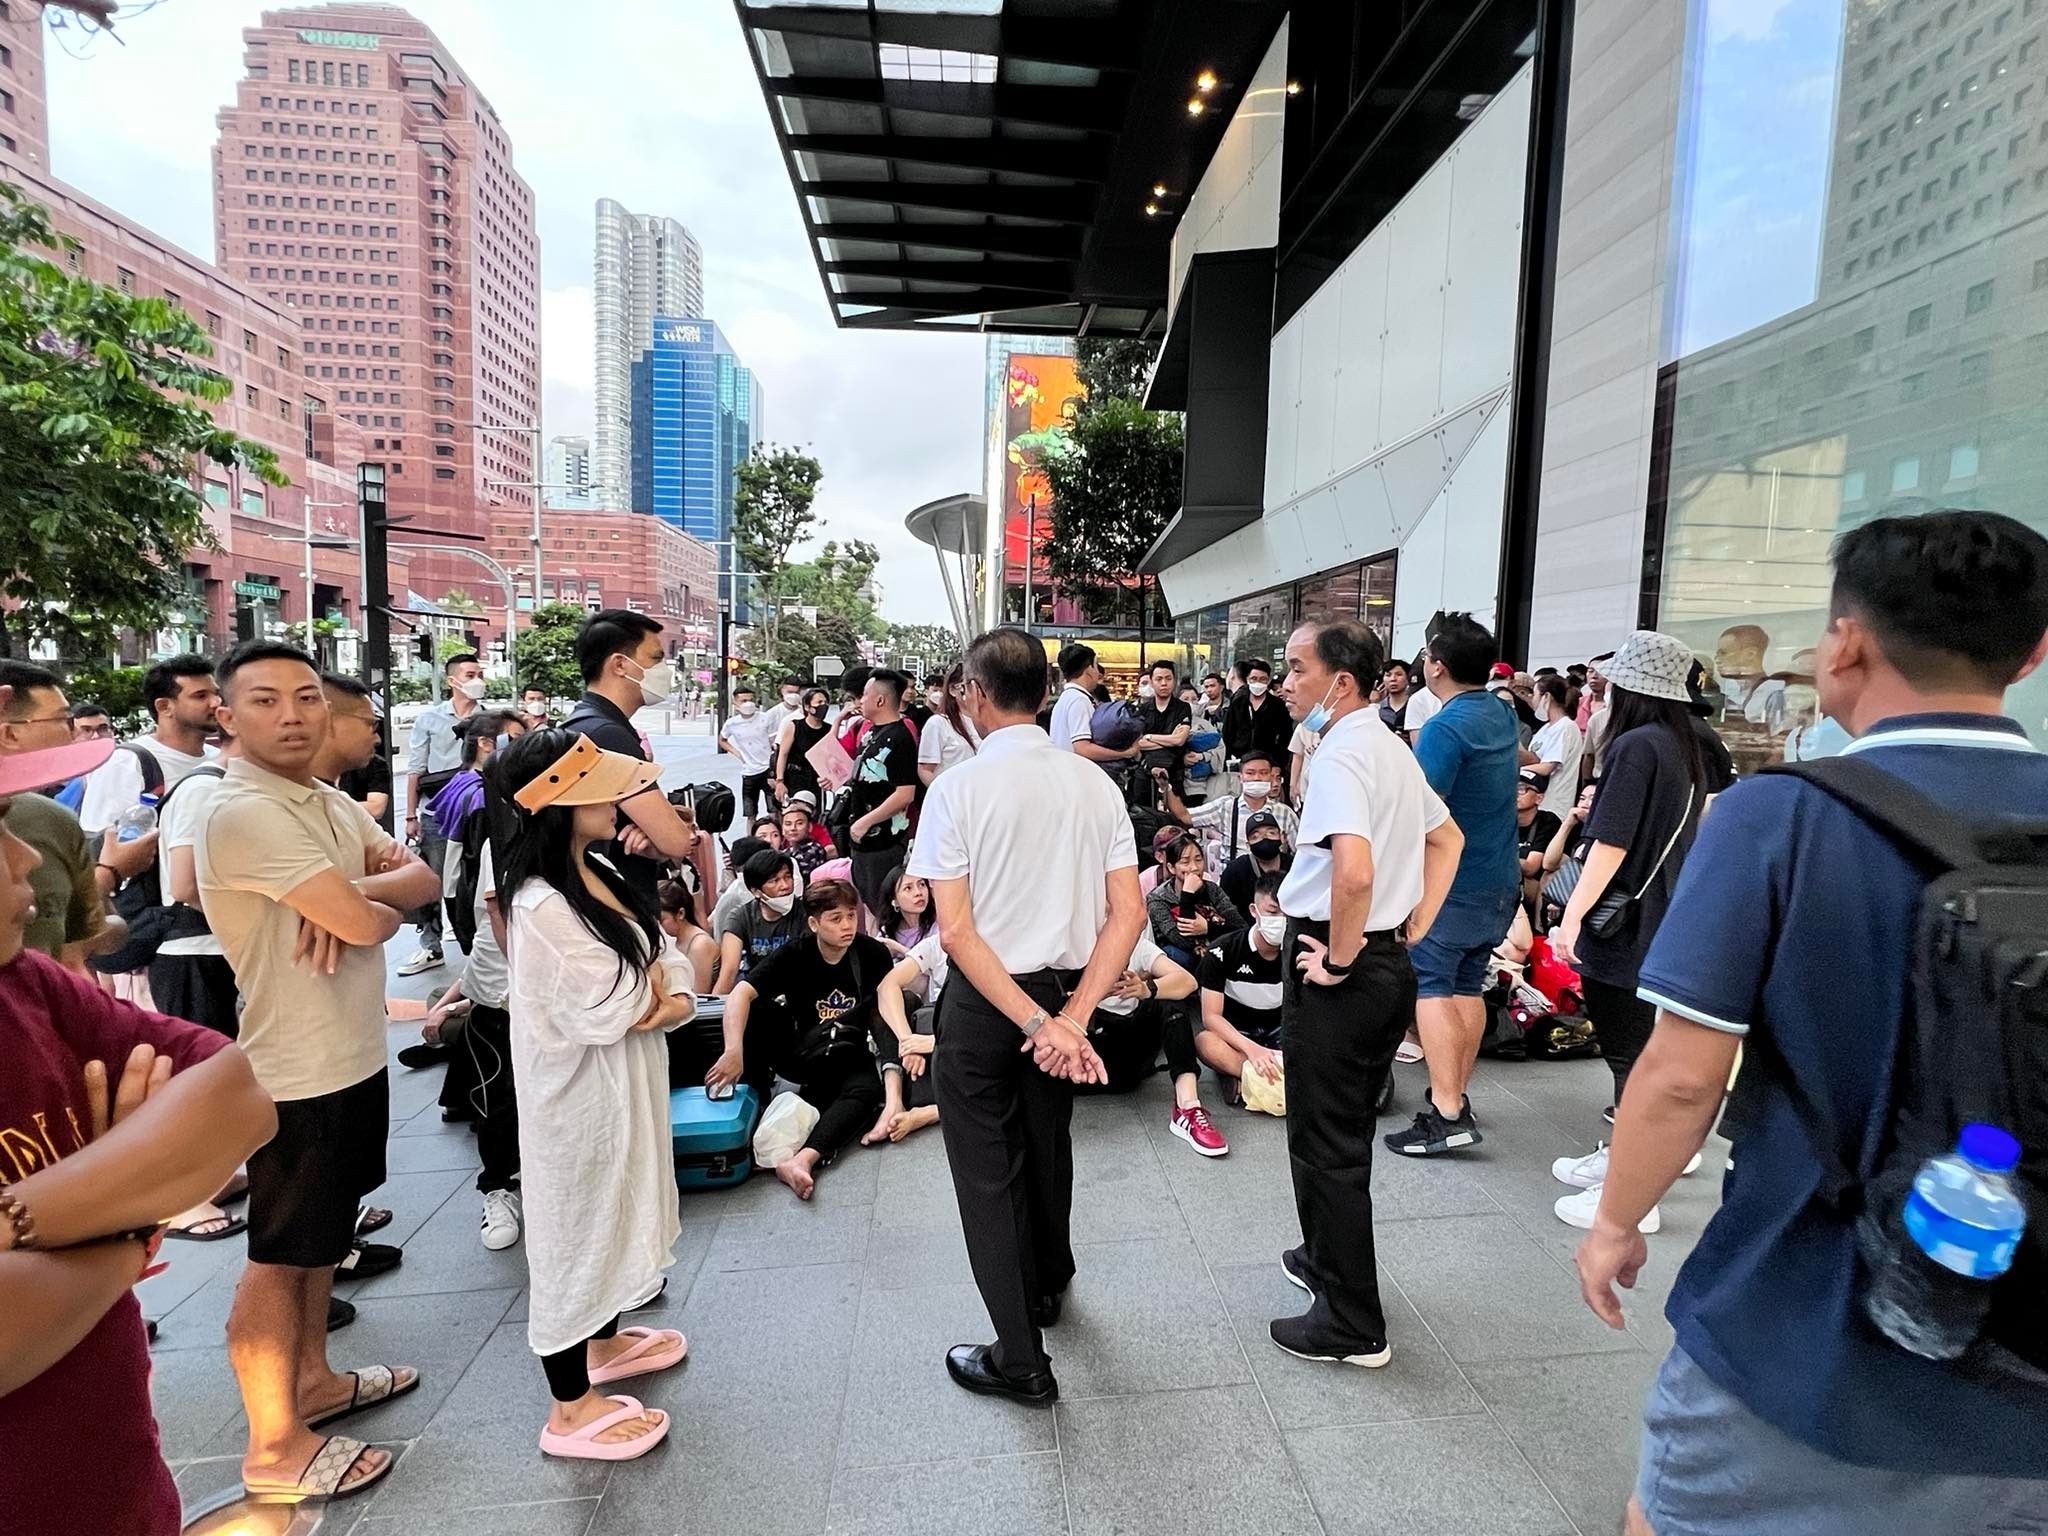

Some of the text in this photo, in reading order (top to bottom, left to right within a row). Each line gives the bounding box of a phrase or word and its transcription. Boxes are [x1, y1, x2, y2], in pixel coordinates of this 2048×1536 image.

[238, 583, 278, 597] Orchard Rd
[819, 1008, 848, 1019] dre
